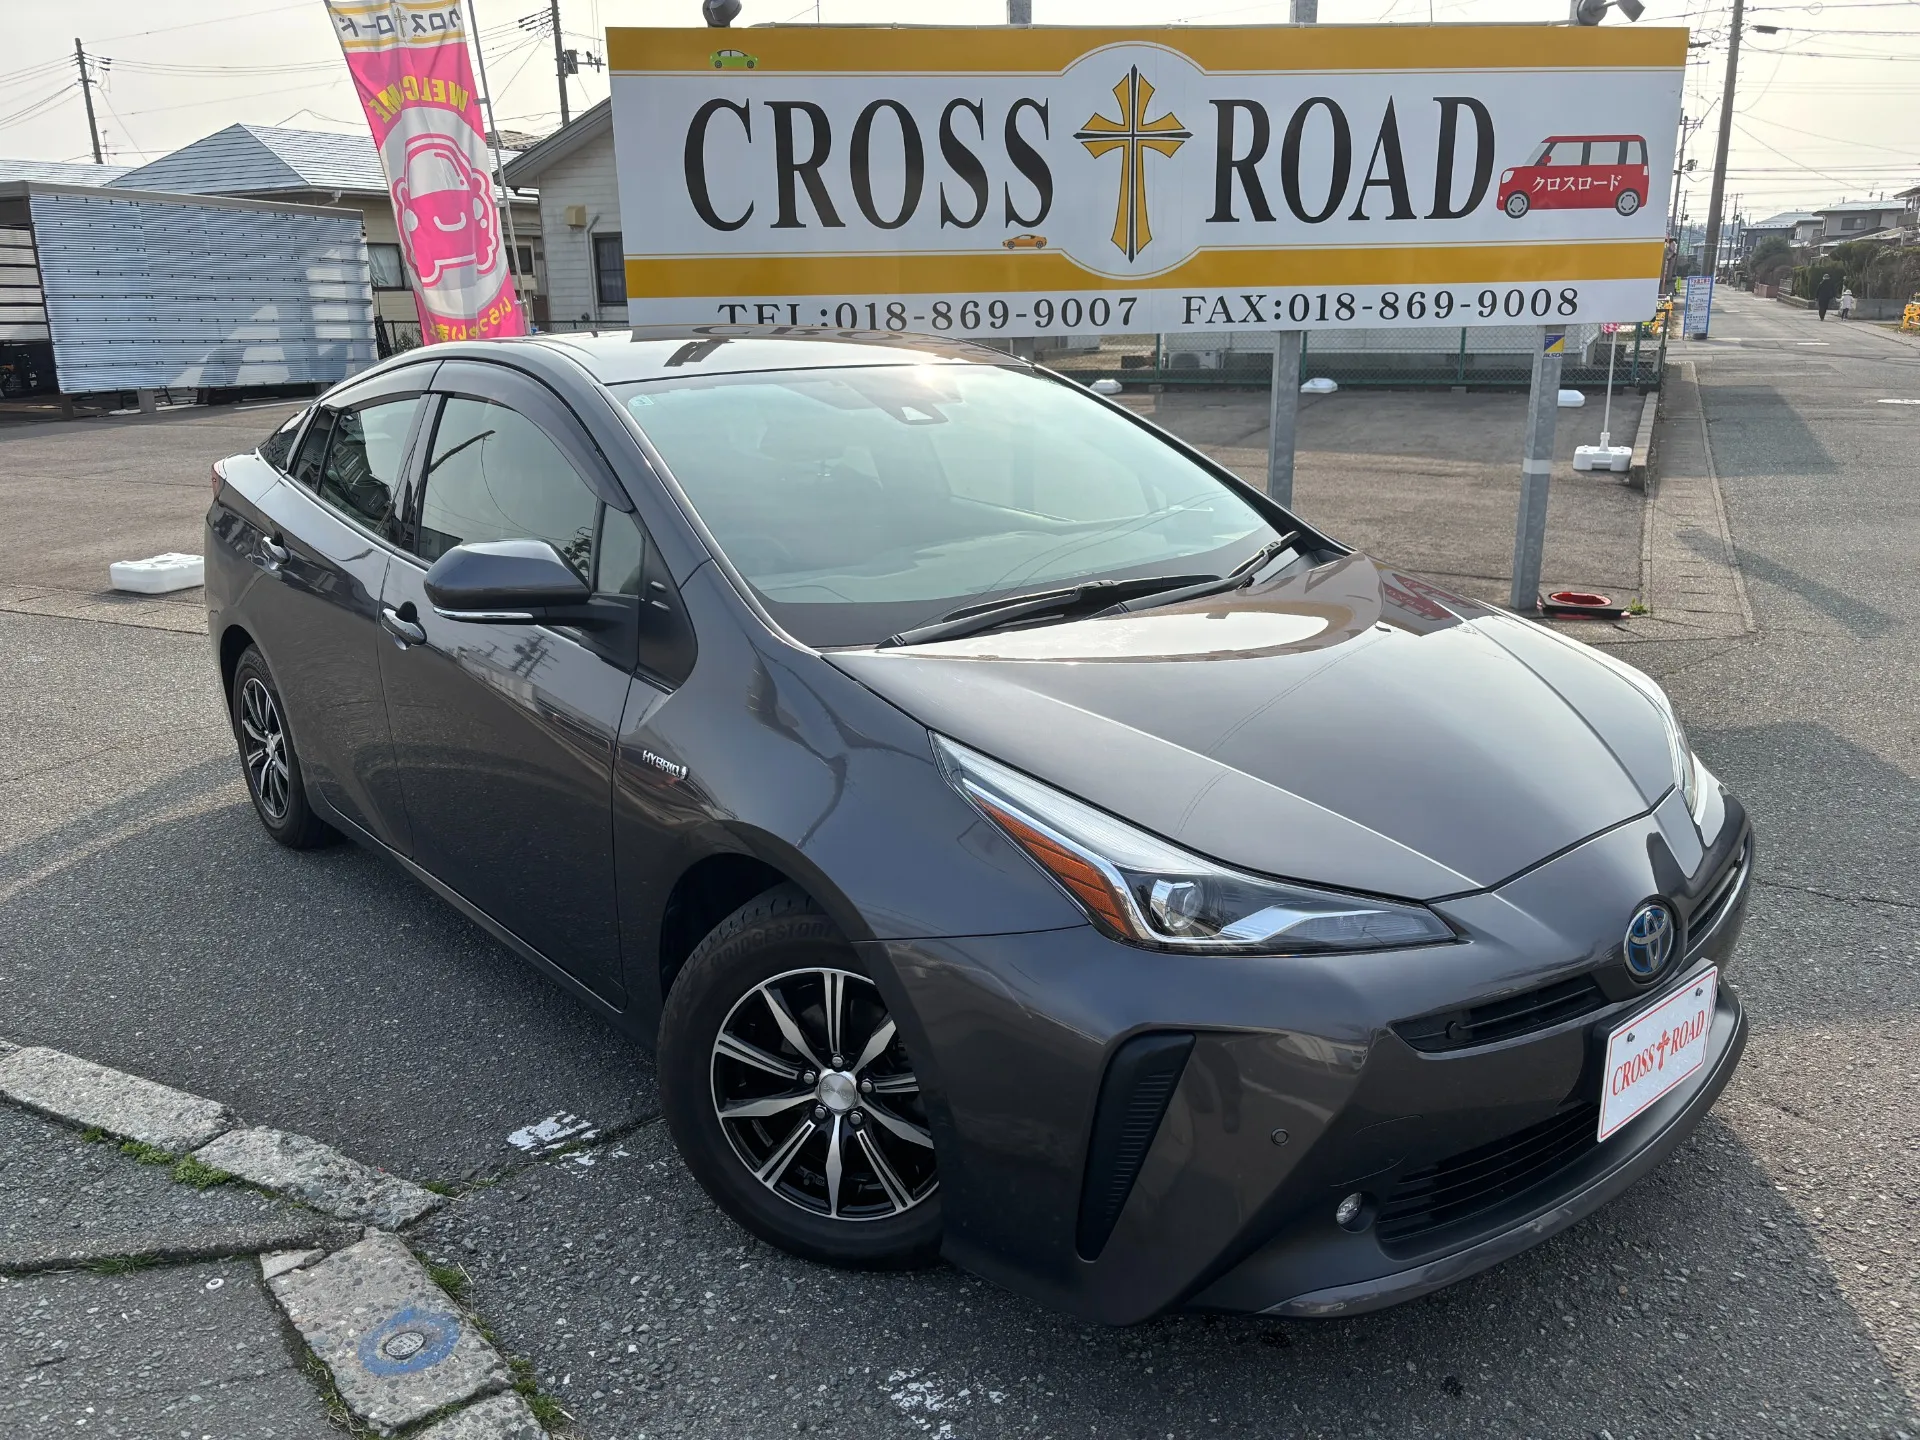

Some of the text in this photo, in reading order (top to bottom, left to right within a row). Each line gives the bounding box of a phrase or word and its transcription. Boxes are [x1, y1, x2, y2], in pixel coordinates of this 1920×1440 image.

[684, 95, 1495, 232] CROSS ROAD
[1531, 174, 1622, 193] クロスロード
[1181, 287, 1579, 325] FAX:018-869-9008
[642, 749, 680, 778] HYBRID
[1612, 1009, 1705, 1097] CROSS ROAD
